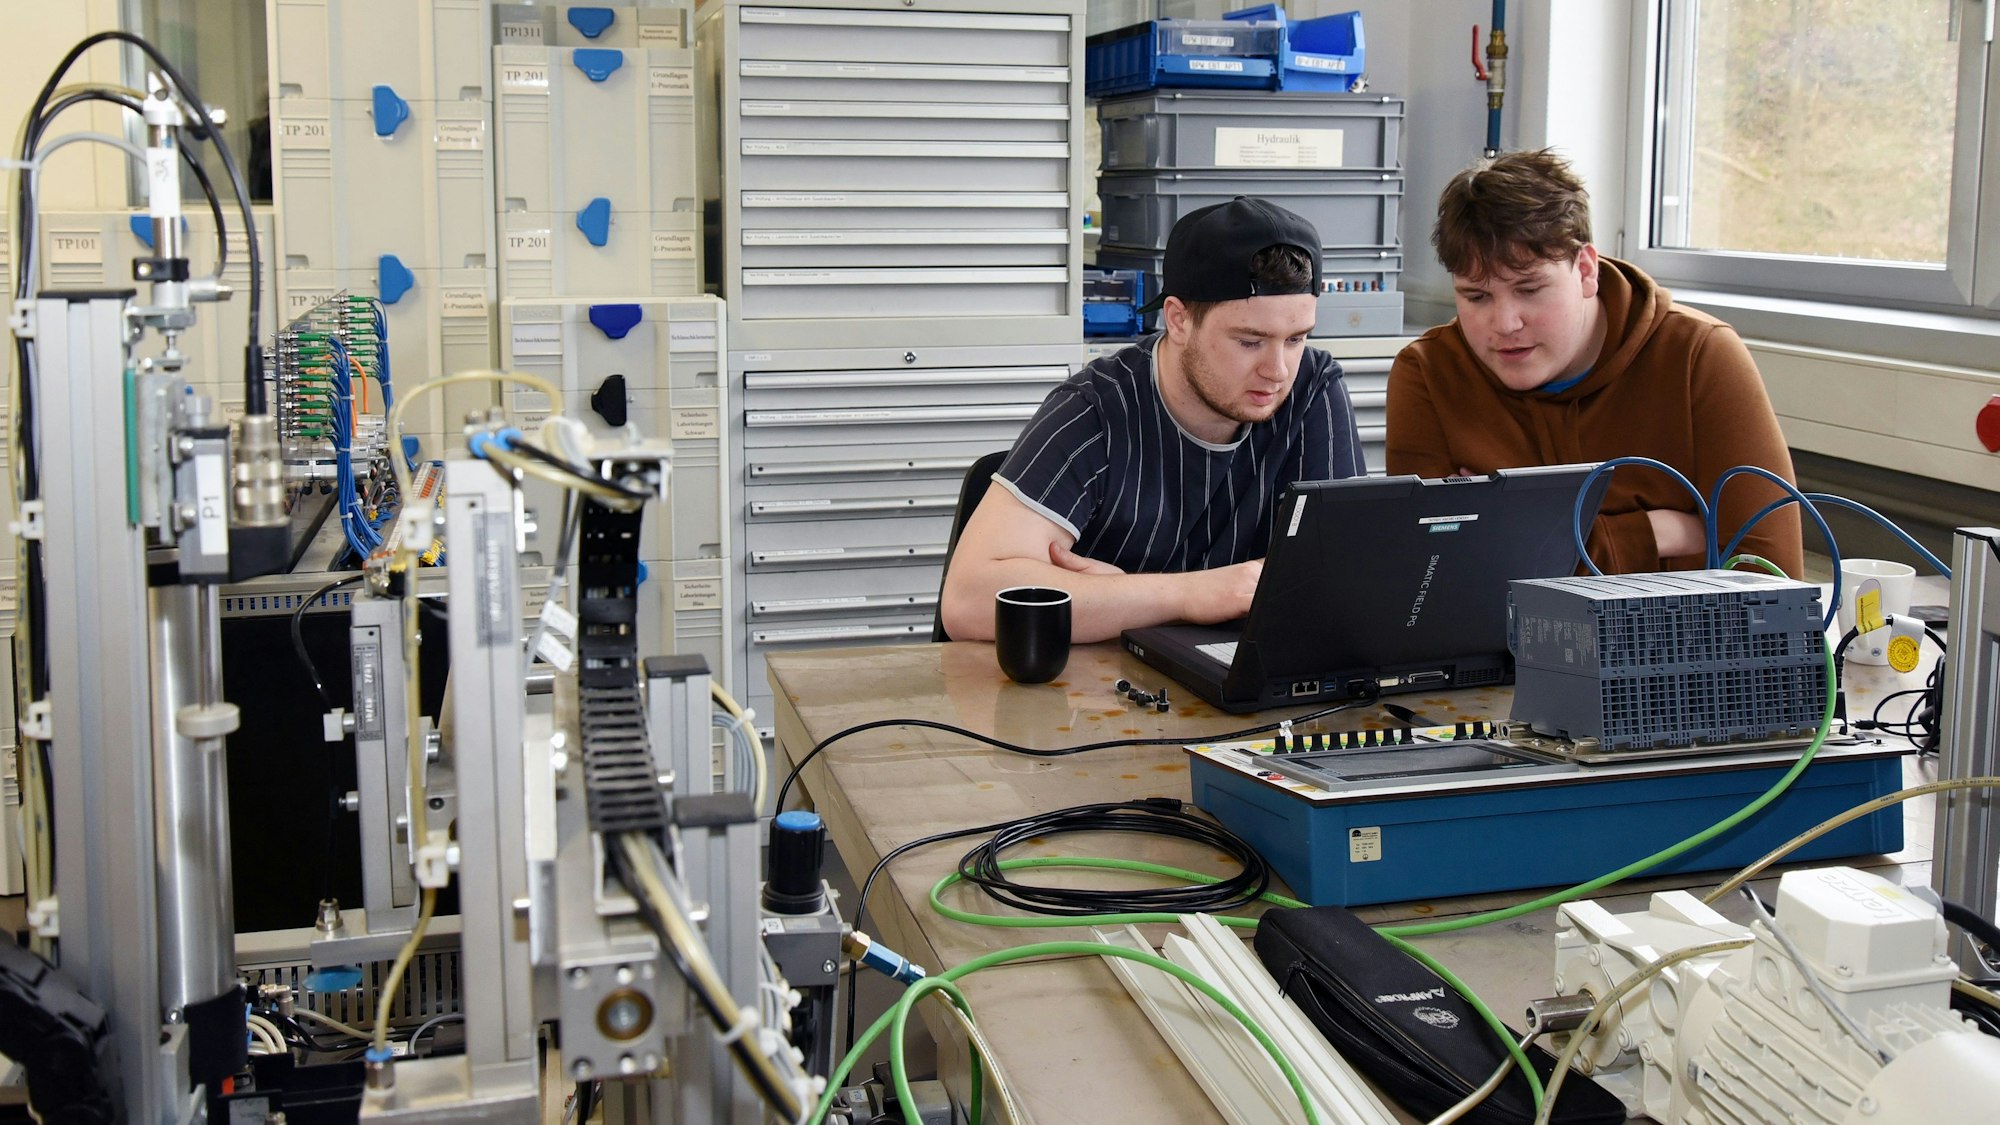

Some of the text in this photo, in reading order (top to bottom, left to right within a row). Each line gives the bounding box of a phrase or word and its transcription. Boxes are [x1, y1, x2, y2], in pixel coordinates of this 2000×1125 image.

[503, 26, 541, 38] TP1311
[505, 71, 543, 81] TP 201
[652, 71, 689, 80] Grundlagen
[651, 81, 690, 90] E-Pneumatik
[284, 125, 325, 136] TP 201
[1257, 133, 1301, 146] Hydraulik
[55, 238, 96, 249] TP101
[508, 237, 547, 248] TP 201
[655, 234, 691, 243] Grundlagen
[653, 245, 692, 253] E-Pneumatik
[291, 295, 307, 307] TP
[445, 291, 483, 301] Grundlagen
[1432, 524, 1459, 532] SIEMENS
[1406, 554, 1440, 627] SIMATIC FIELD PG
